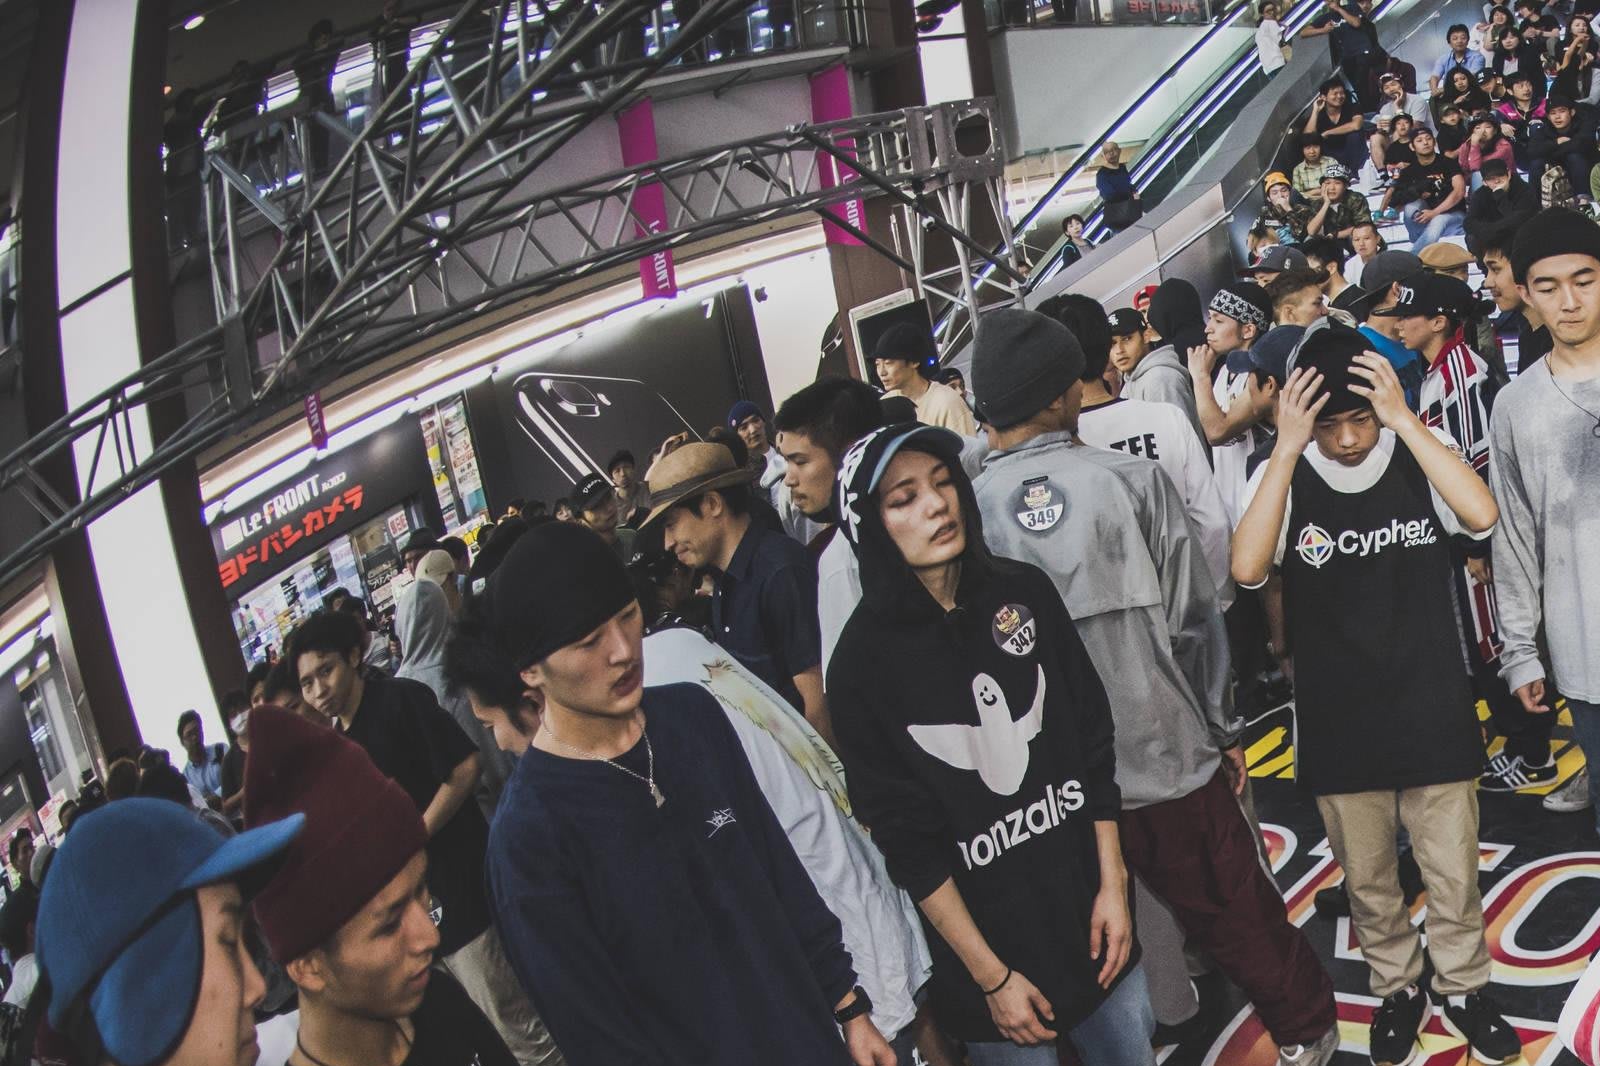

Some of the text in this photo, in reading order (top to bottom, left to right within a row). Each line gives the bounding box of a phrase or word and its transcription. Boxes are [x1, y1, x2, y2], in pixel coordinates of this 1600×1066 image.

[702, 297, 714, 318] 7
[1027, 508, 1056, 527] 349
[219, 485, 363, 588] ヨドバシカメラ
[1338, 518, 1429, 556] Cypher
[1404, 527, 1437, 547] code
[1009, 625, 1036, 654] 342
